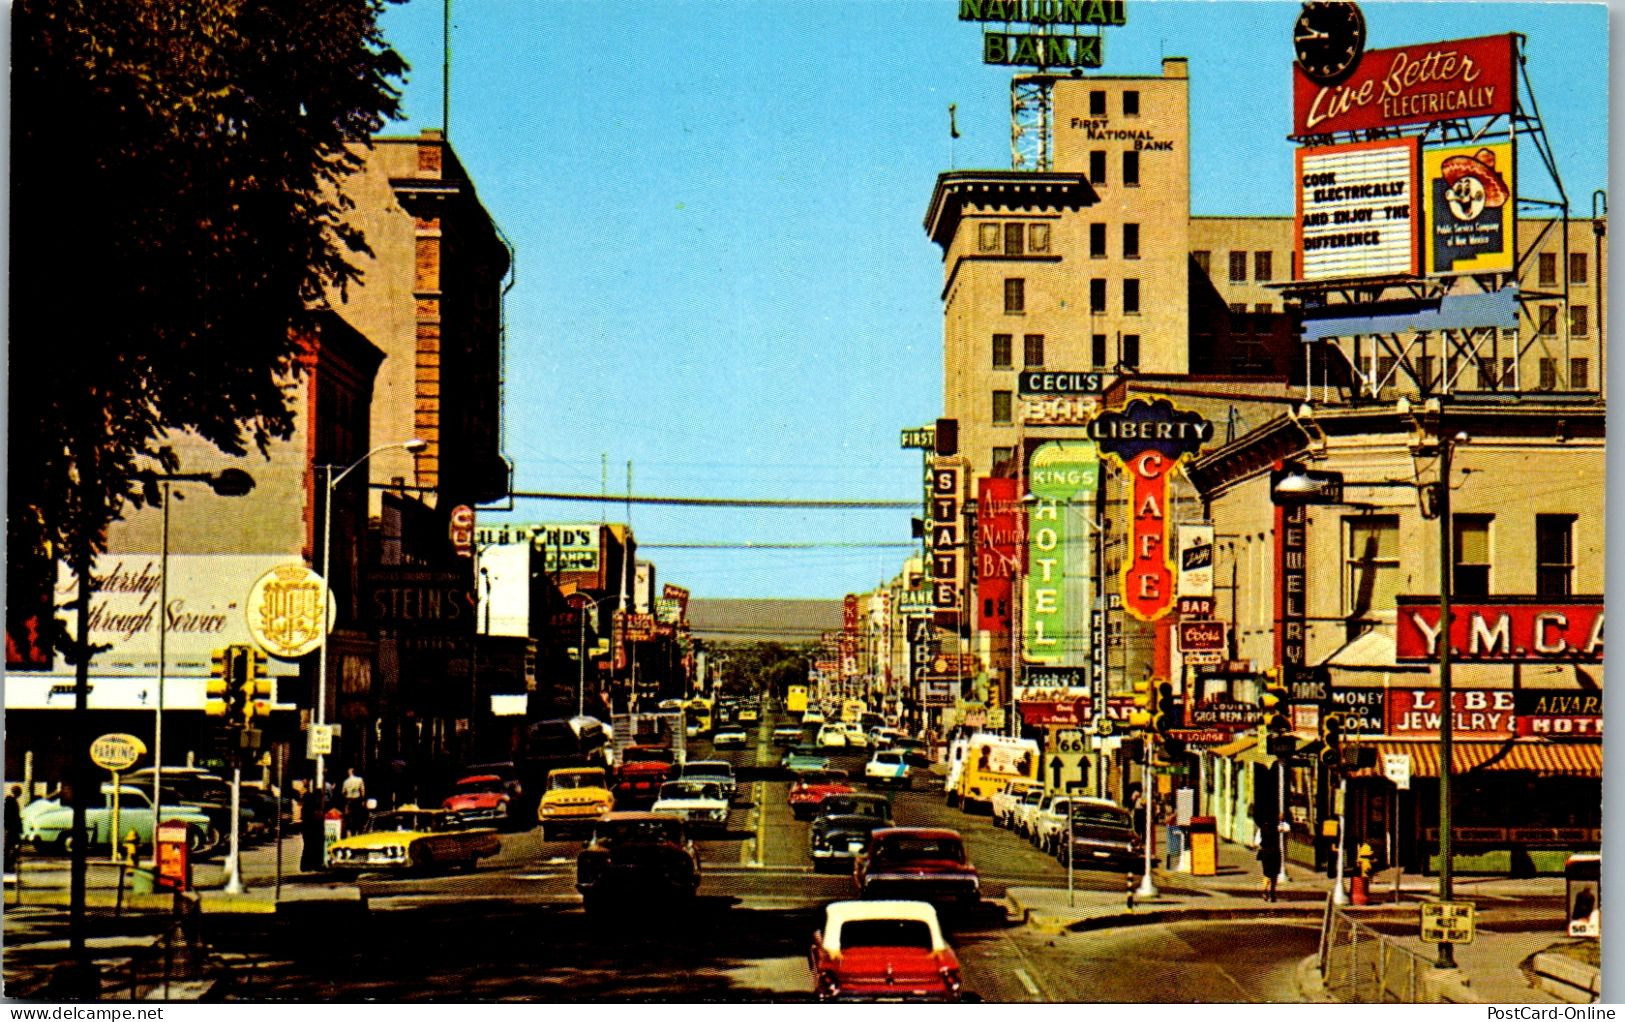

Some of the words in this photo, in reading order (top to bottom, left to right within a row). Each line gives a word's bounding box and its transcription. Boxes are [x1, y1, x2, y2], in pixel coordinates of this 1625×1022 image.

[959, 0, 1126, 25] NATIONAL
[985, 33, 1102, 66] BANK
[1307, 82, 1374, 128] Live
[1378, 51, 1479, 104] Better
[1384, 86, 1495, 119] ELECTRICALLY
[1087, 130, 1154, 142] NATIONAL
[1134, 140, 1173, 151] BANK
[1303, 172, 1336, 188] COOK
[1314, 181, 1404, 203] ELECTRICALLY
[1303, 213, 1328, 228] AND
[1334, 208, 1373, 224] ENJOY
[1385, 204, 1410, 219] THE
[1304, 230, 1380, 250] DIFFERENCE
[1029, 373, 1099, 391] CECIL'S
[1024, 396, 1098, 420] BAR
[1093, 421, 1208, 440] LIBERTY
[1032, 470, 1094, 484] KINGS
[1136, 455, 1164, 600] CAFE
[938, 472, 953, 604] STATE
[1036, 498, 1057, 645] HOTEL
[1286, 504, 1303, 664] JEWELRY
[1181, 600, 1210, 613] BAR
[1184, 628, 1220, 644] Coors
[1332, 691, 1384, 705] MONEY
[95, 745, 136, 761] PARKING
[1060, 739, 1083, 751] 66
